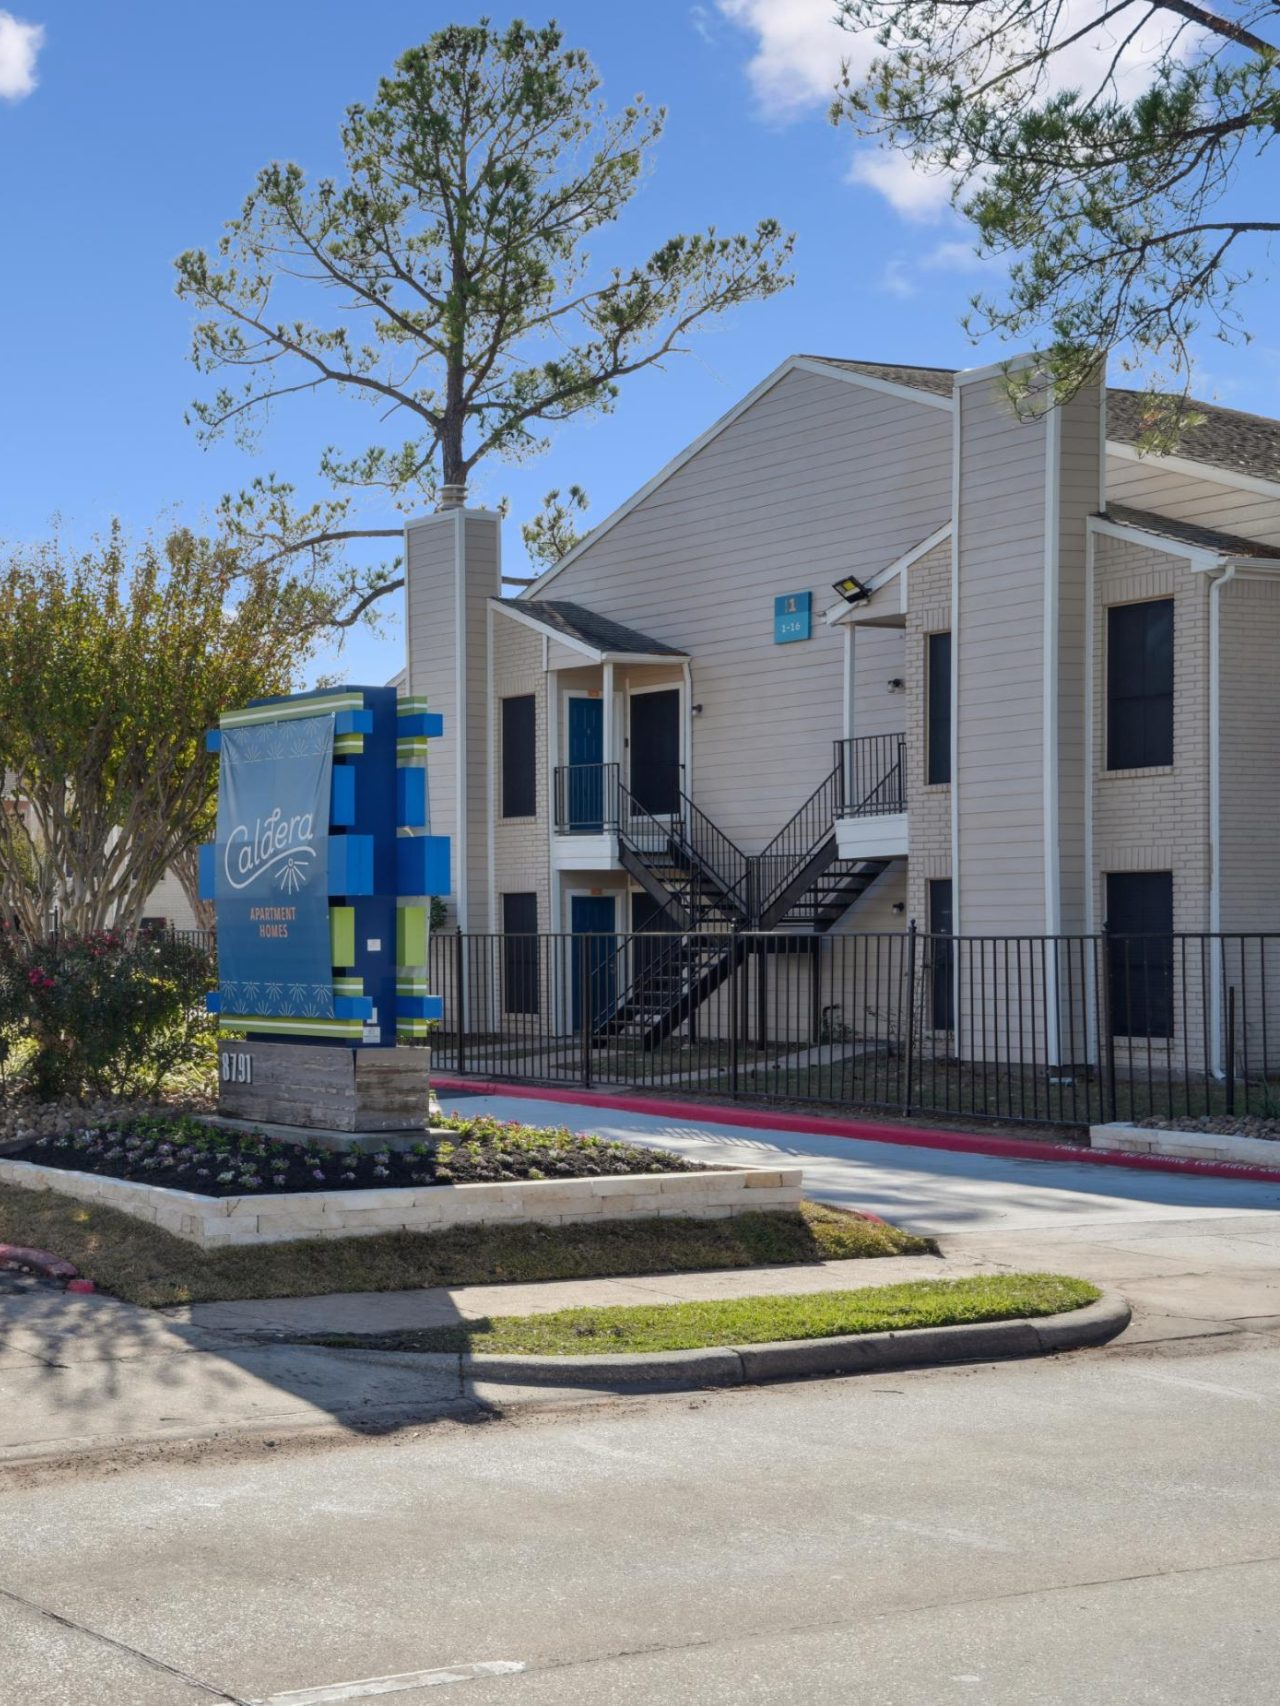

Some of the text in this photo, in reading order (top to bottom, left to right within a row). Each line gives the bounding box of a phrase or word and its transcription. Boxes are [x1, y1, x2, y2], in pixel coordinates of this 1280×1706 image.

[788, 598, 797, 612] 1
[224, 807, 316, 889] Caldera
[249, 906, 296, 921] APARTMENT
[259, 924, 288, 938] HOMES
[222, 1052, 252, 1083] 8791
